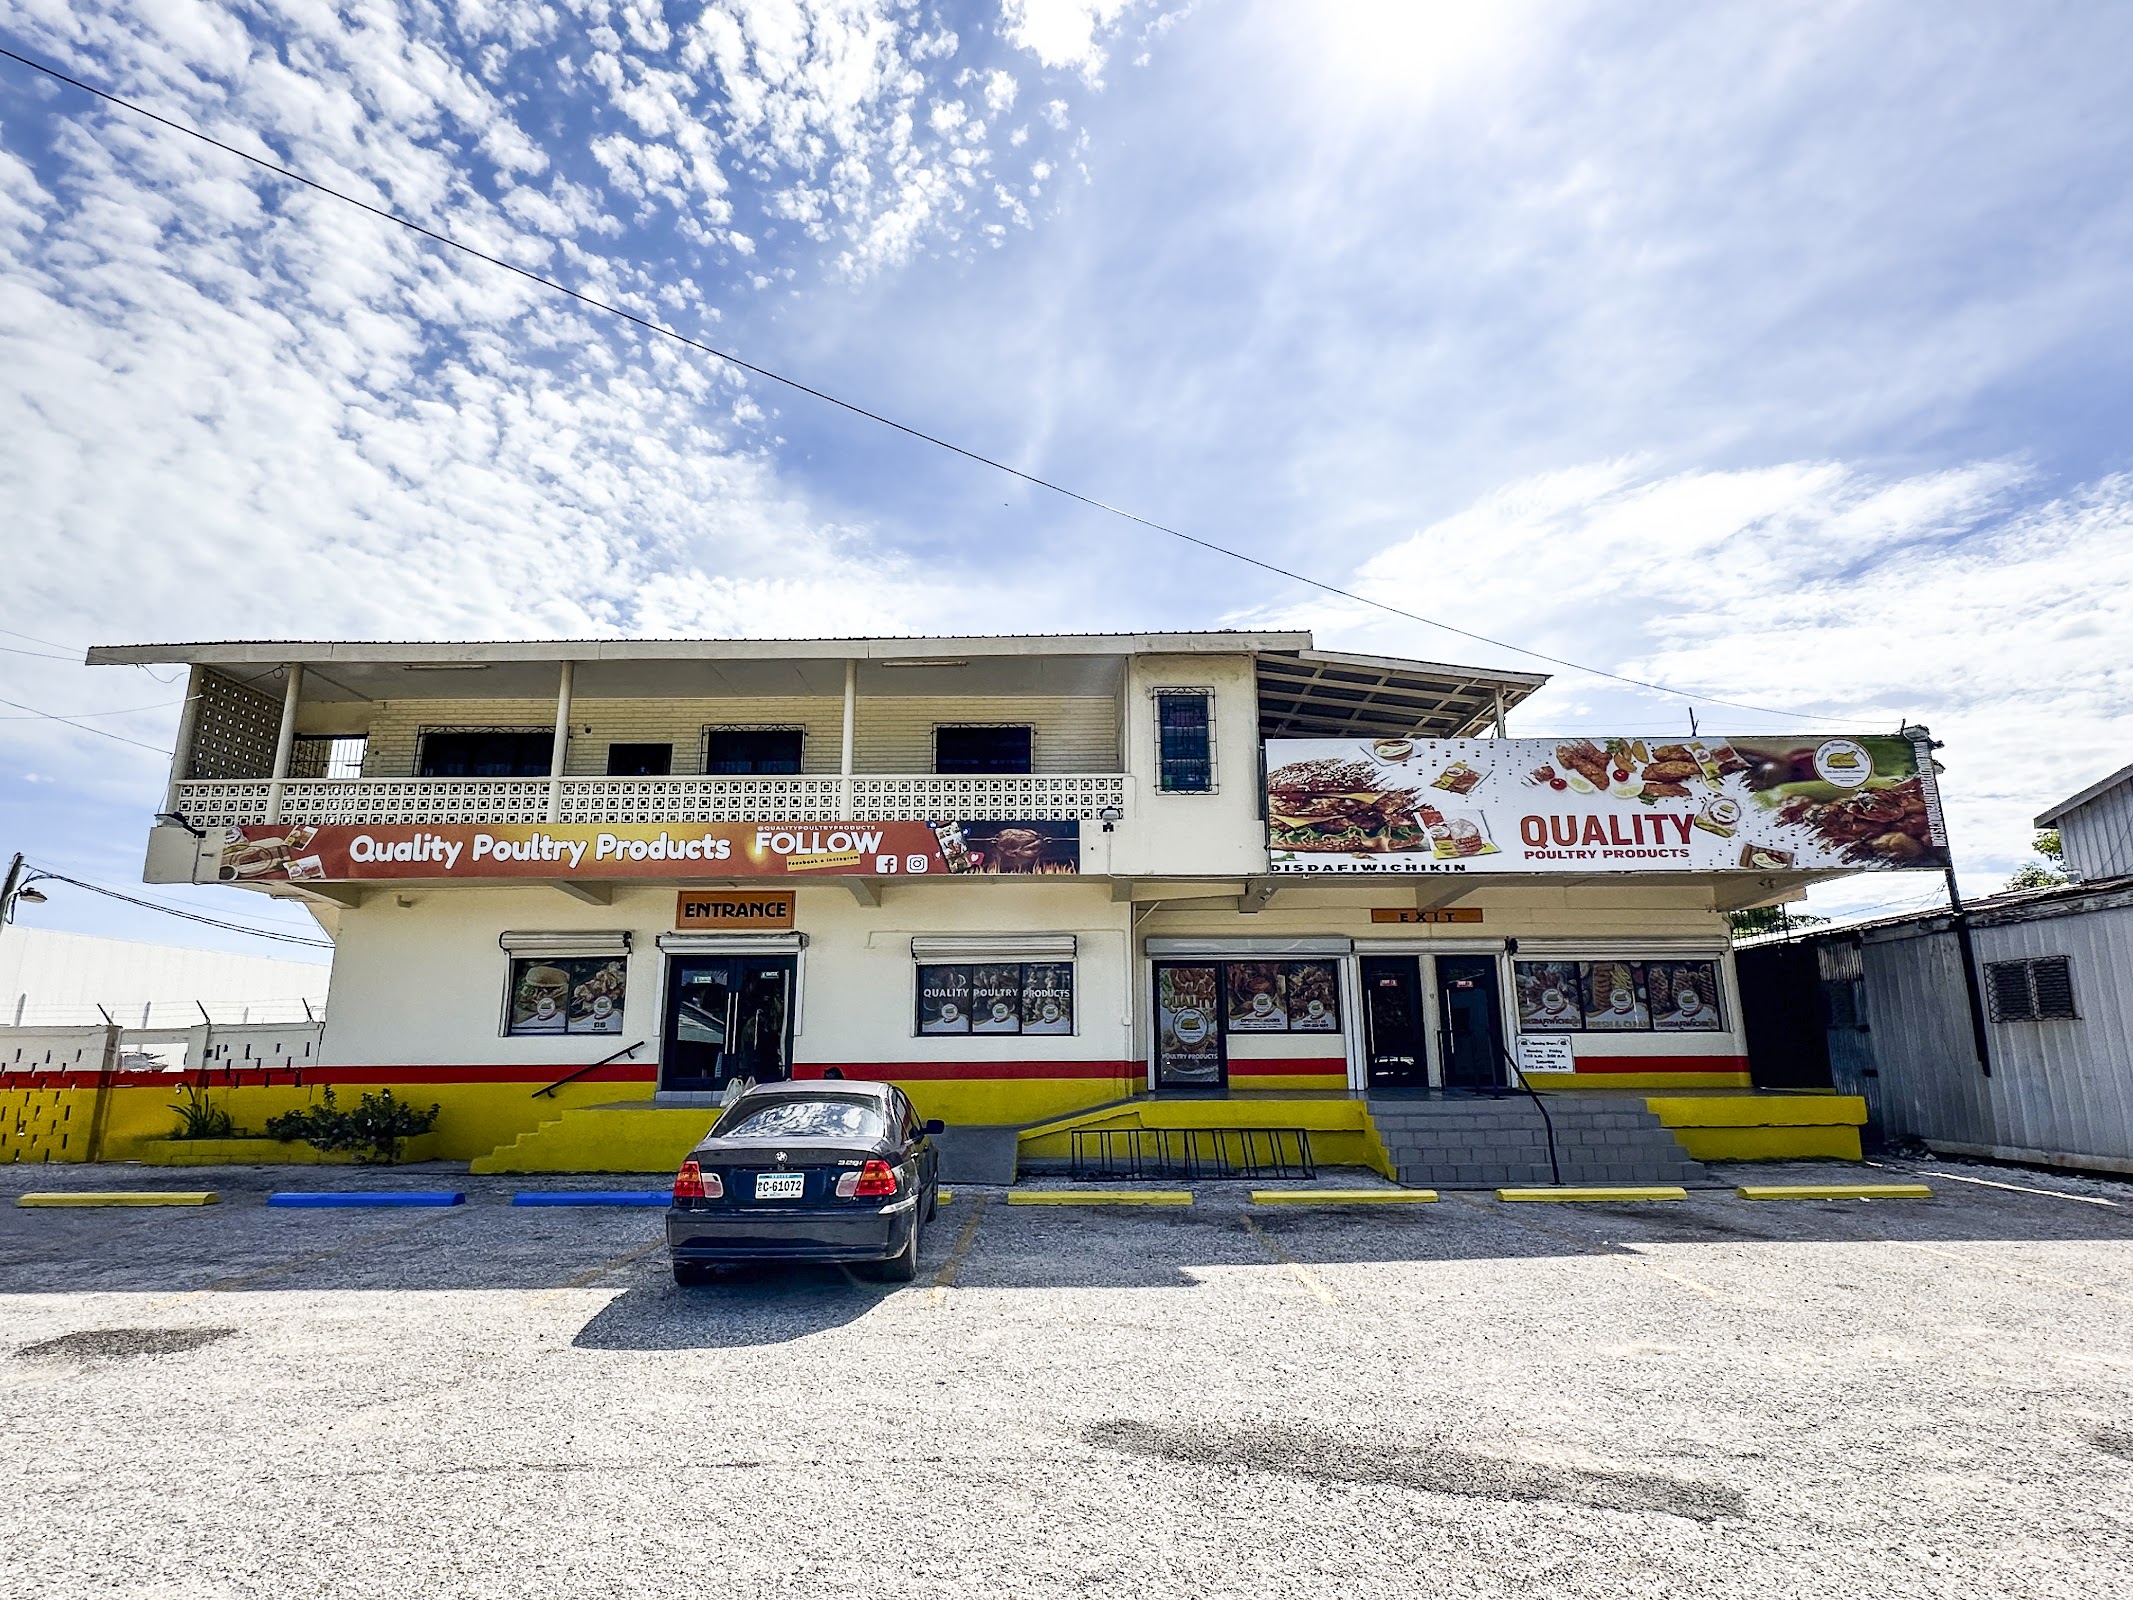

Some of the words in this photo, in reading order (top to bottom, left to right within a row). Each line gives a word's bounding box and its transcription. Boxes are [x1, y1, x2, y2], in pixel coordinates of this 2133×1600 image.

[1520, 814, 1695, 849] QUALITY
[755, 831, 884, 854] FOLLOW
[349, 832, 462, 869] Quality
[472, 831, 588, 868] Poultry
[595, 831, 731, 862] Products
[1524, 850, 1597, 860] POULTRY
[1603, 848, 1690, 859] PRODUCTS
[1271, 863, 1467, 872] DISDAFIWICHIKIN
[684, 902, 787, 918] ENTRANCE
[1399, 912, 1456, 923] EXIT
[923, 987, 970, 998] QUALITY
[973, 988, 1019, 997] POULTRY
[1022, 988, 1070, 998] PRODUCTS
[1162, 994, 1217, 1014] QUALITY
[1187, 1052, 1219, 1060] PRODUCTS
[763, 1180, 802, 1192] C-61072
